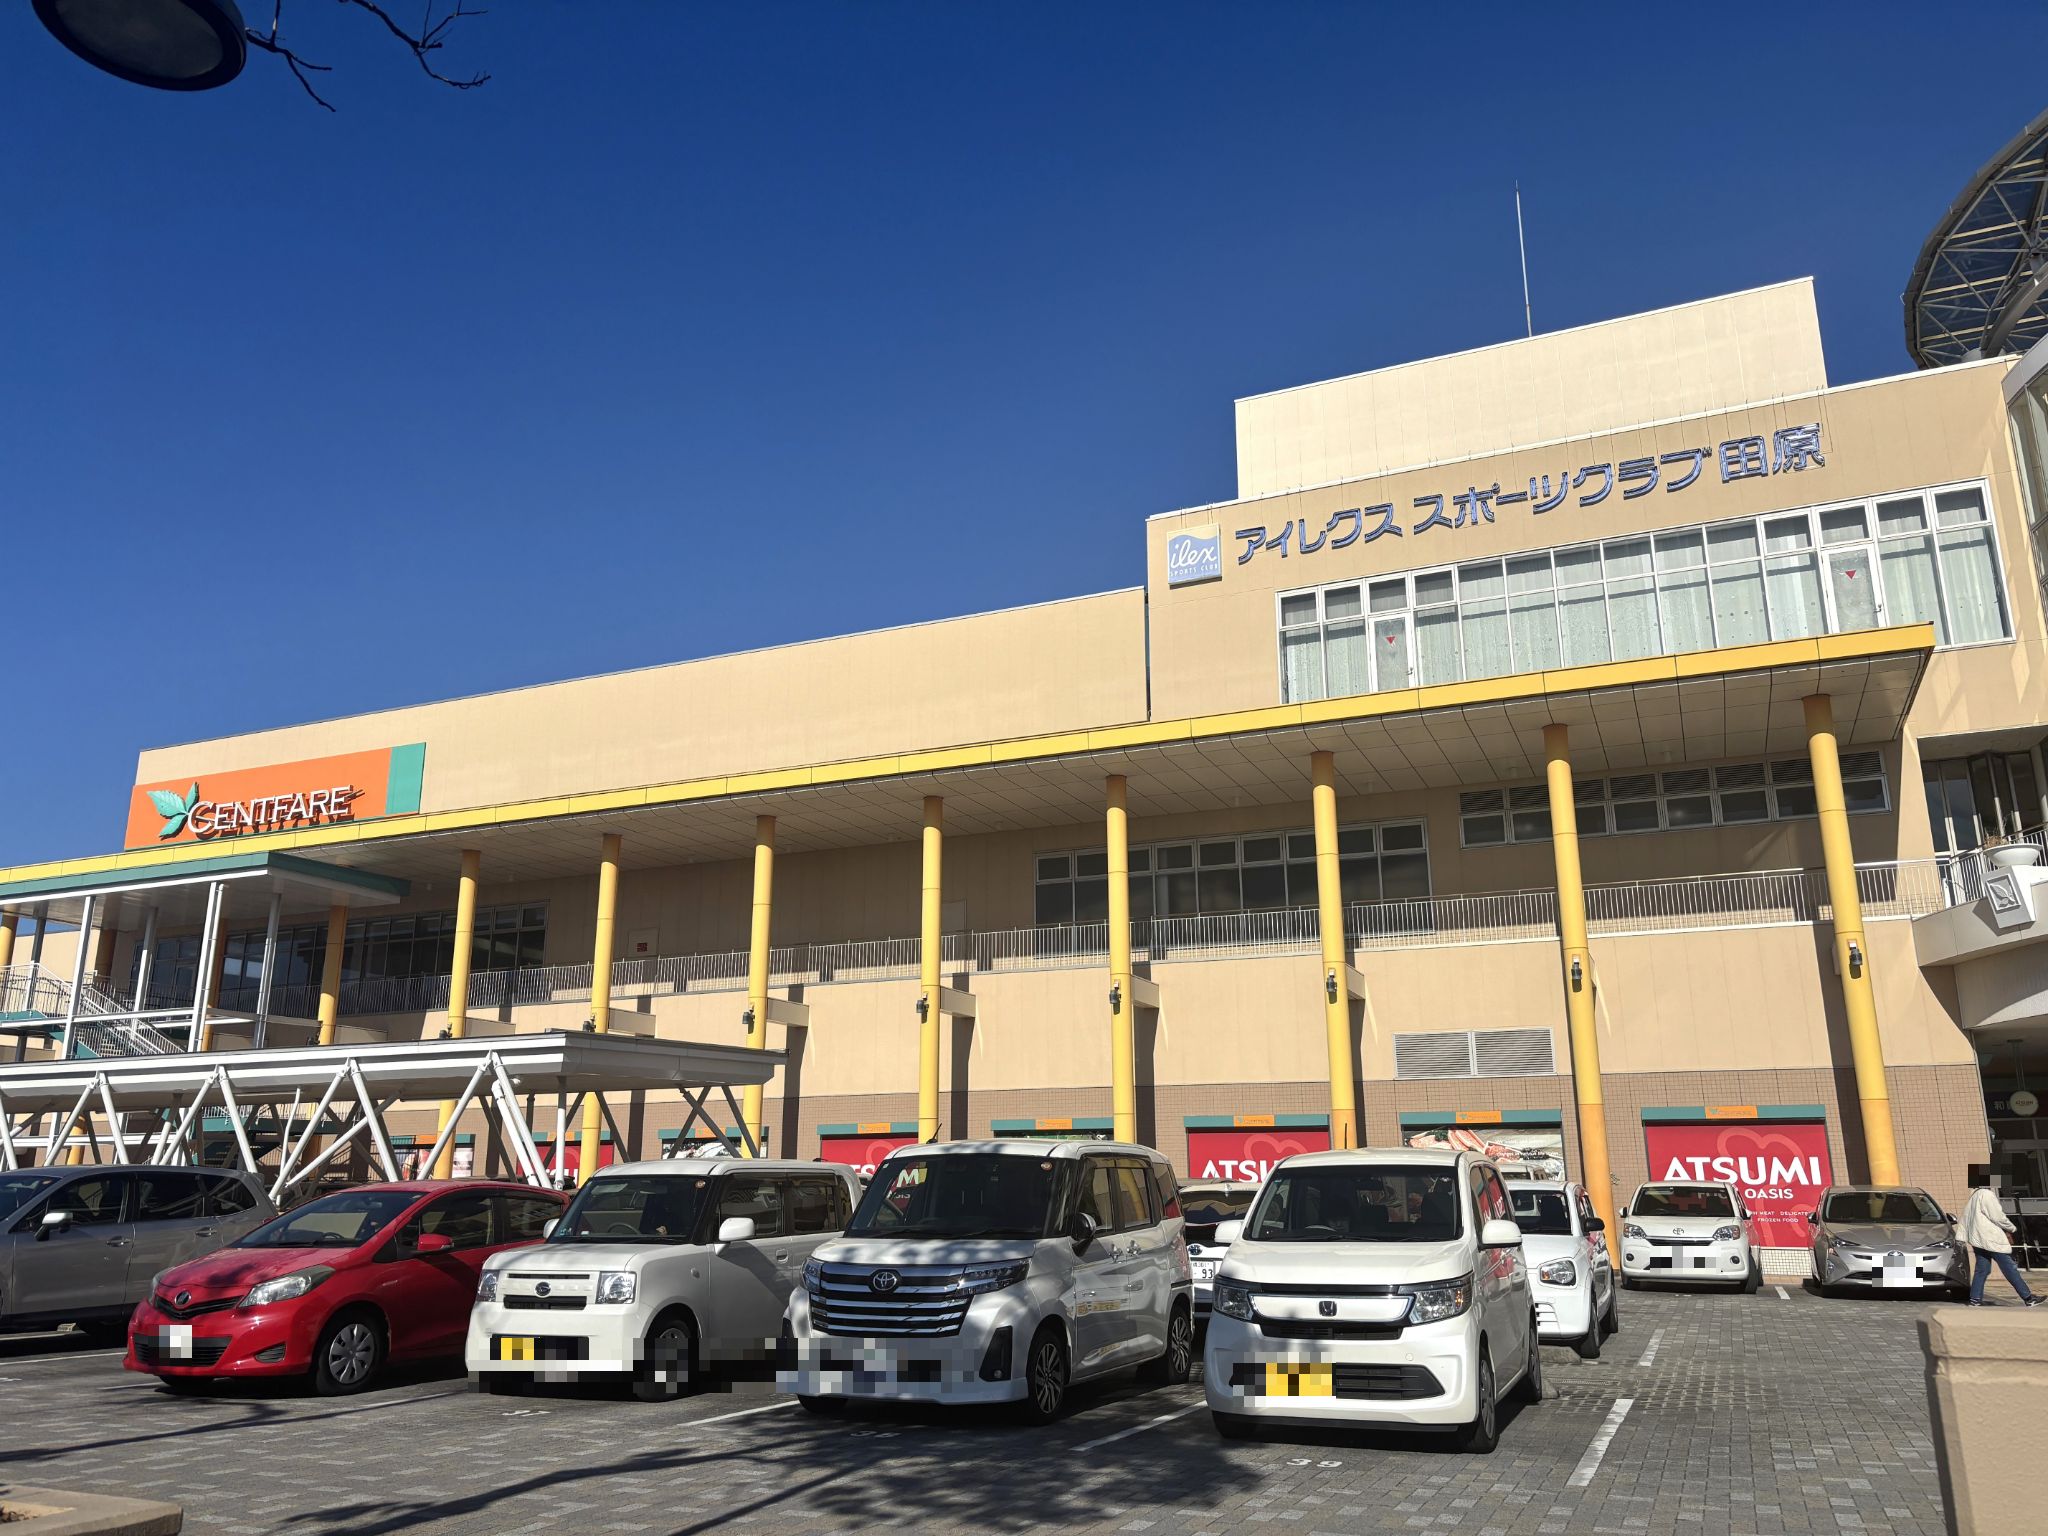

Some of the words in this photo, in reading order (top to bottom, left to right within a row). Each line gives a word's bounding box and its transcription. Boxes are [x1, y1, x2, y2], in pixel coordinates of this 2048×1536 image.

[1235, 502, 1403, 565] アイレクス
[1413, 447, 1713, 536] スポーツクラブ
[1718, 422, 1826, 485] 田原
[1170, 539, 1217, 569] ilex
[1170, 567, 1197, 577] SPORTS
[1200, 563, 1218, 571] CLUB
[187, 785, 351, 834] CENTFARE
[1663, 1156, 1823, 1186] ATSUMI
[1744, 1188, 1794, 1199] OASIS
[1286, 1458, 1343, 1468] 39
